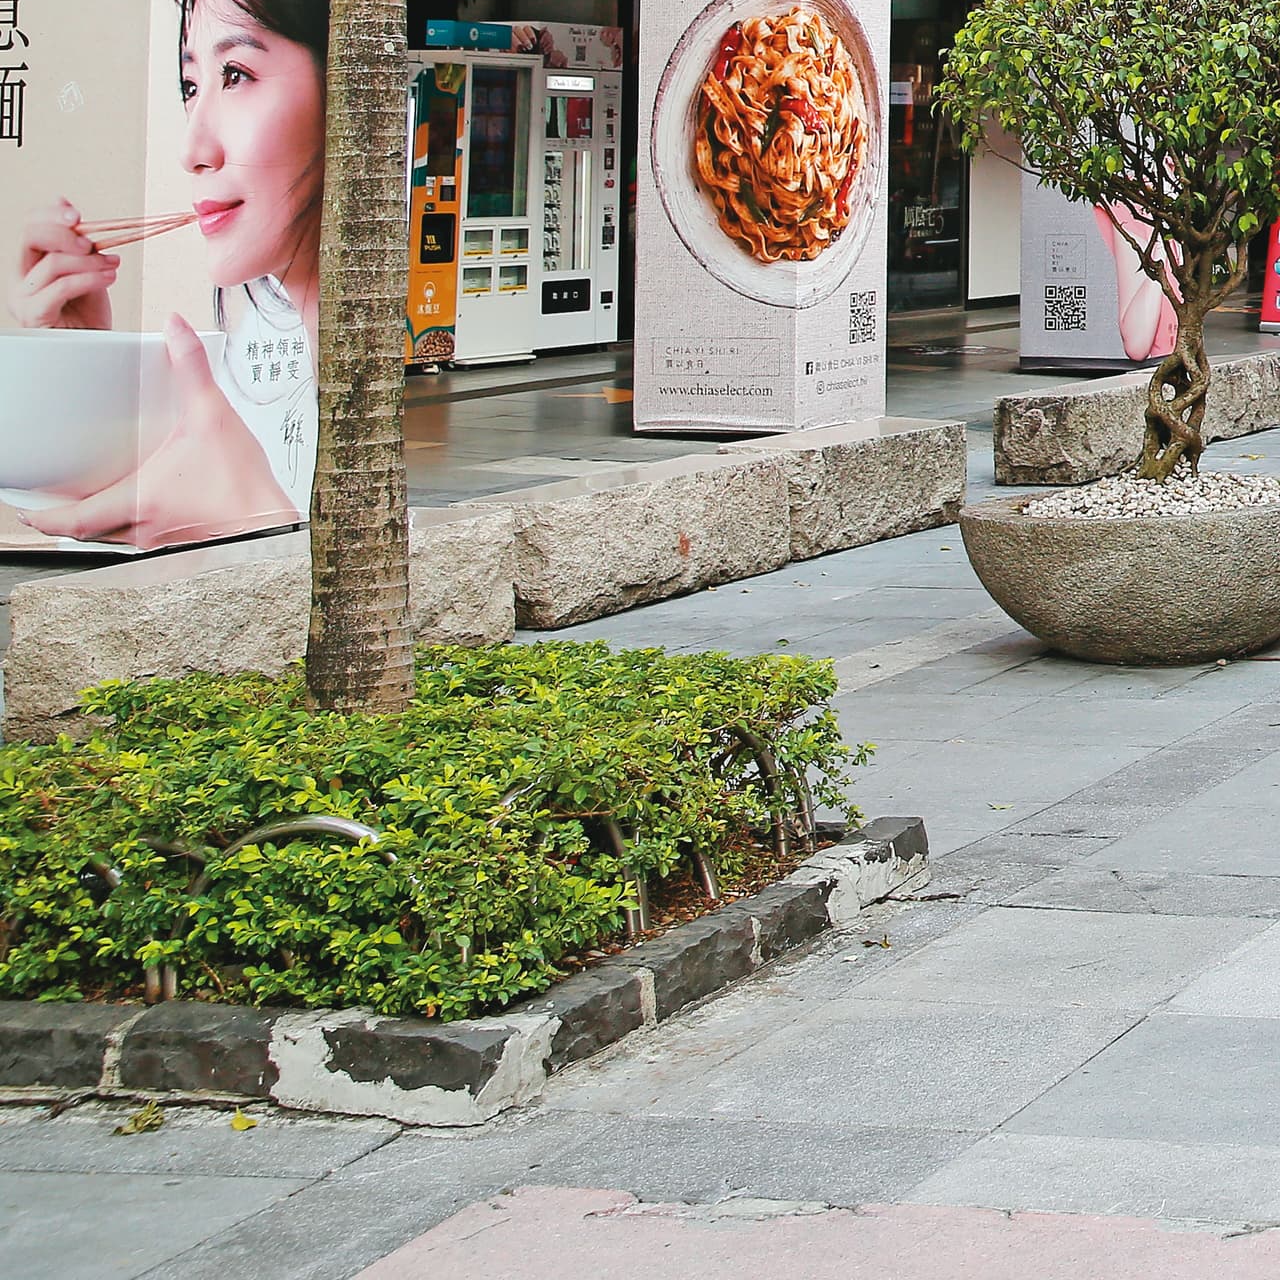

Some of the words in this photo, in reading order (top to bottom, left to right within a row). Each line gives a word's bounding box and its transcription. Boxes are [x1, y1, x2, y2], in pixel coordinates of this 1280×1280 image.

[246, 337, 305, 361] 精神領袖
[659, 384, 773, 397] www.chiaselect.com
